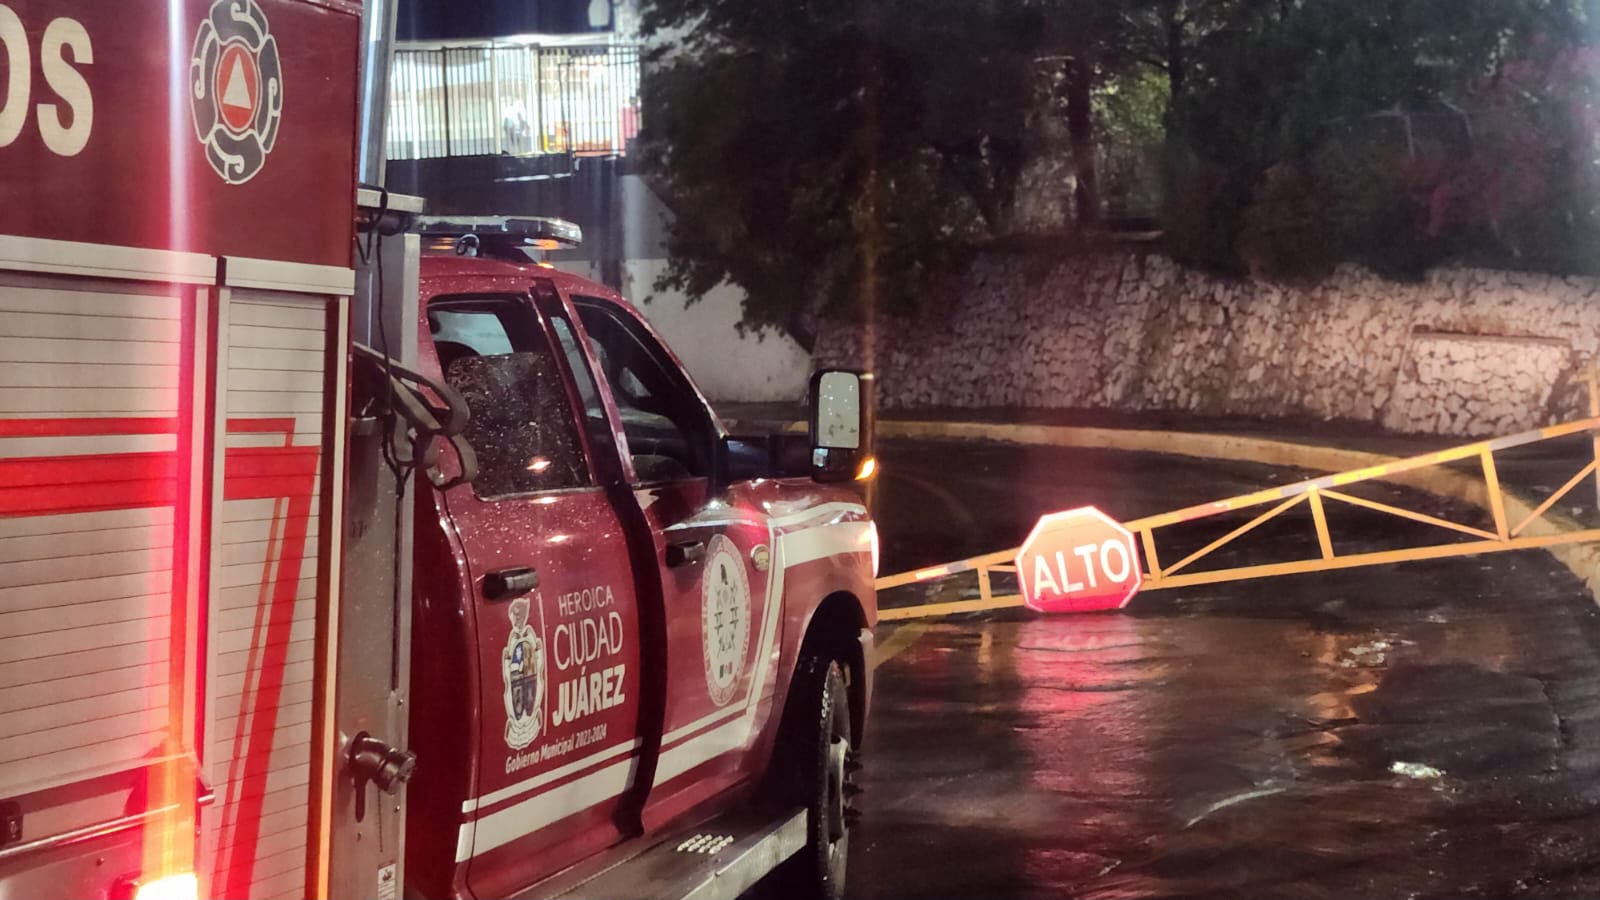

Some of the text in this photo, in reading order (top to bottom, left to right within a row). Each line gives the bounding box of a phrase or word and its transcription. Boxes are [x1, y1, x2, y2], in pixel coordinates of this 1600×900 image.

[1033, 539, 1130, 599] ALTO
[558, 585, 614, 616] HEROICA
[553, 611, 622, 670] CIUDAD
[552, 663, 626, 727] JUÁREZ
[505, 750, 539, 774] Gobierno
[540, 733, 575, 762] Municipal
